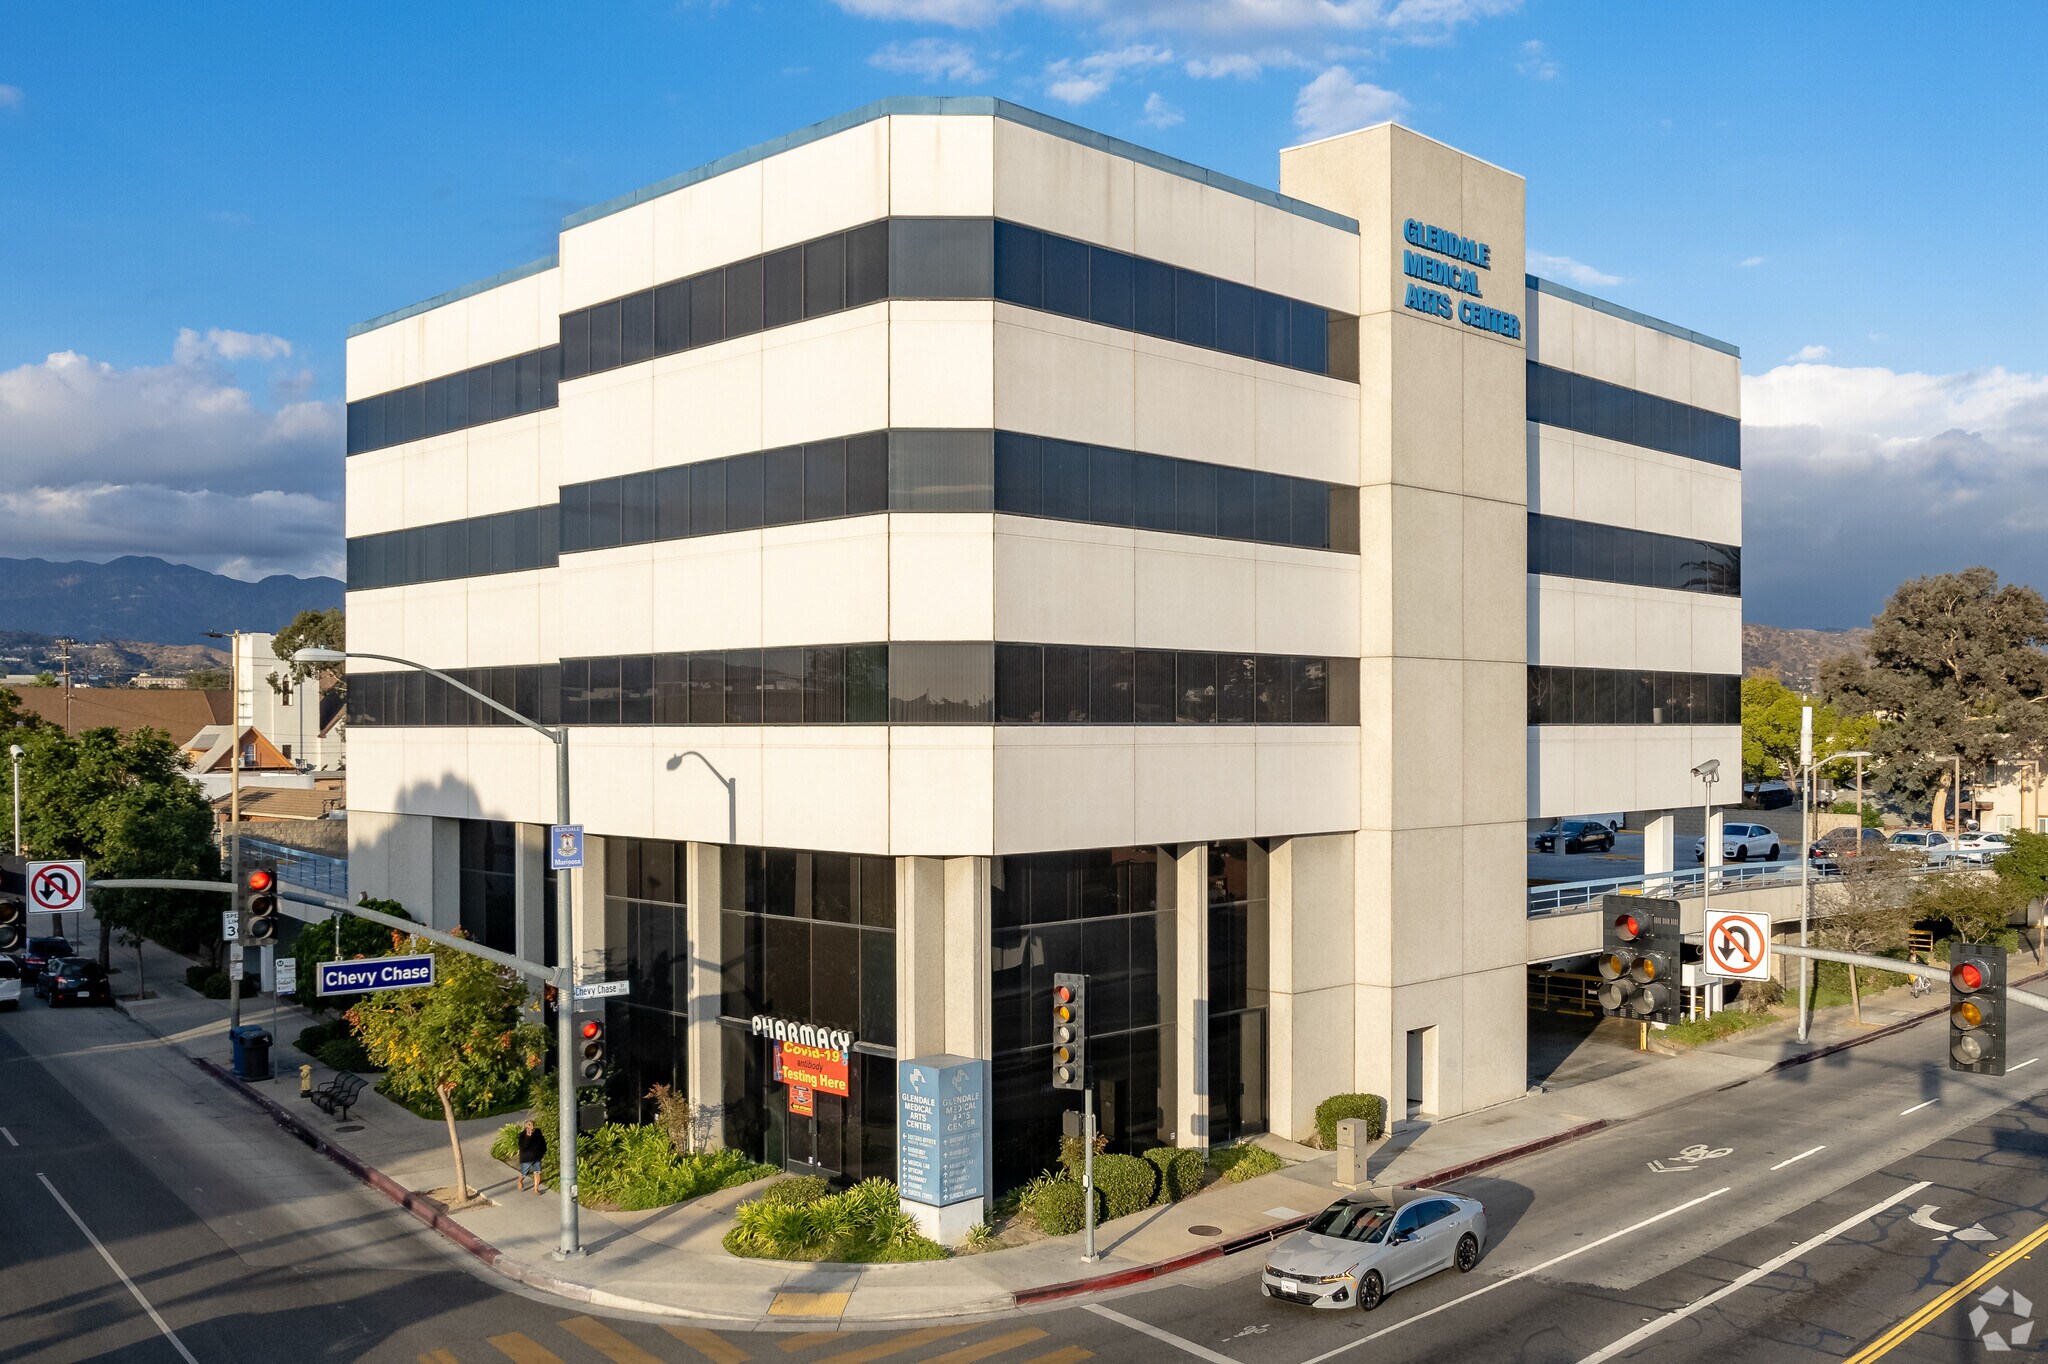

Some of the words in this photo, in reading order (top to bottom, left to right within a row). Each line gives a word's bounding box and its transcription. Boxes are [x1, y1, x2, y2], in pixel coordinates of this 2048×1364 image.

[1404, 218, 1490, 270] GLENDALE
[1404, 249, 1482, 298] MEDICAL
[1404, 283, 1453, 320] ARTS
[1458, 299, 1521, 340] CENTER
[326, 971, 377, 986] Chevy
[382, 966, 428, 981] Chase
[576, 987, 596, 996] Chevy
[598, 985, 616, 994] Chase
[752, 1015, 851, 1053] PHARMACY
[783, 1041, 840, 1062] Covid-19
[797, 1060, 824, 1072] antibody
[782, 1066, 818, 1087] Testing
[820, 1074, 846, 1090] Here
[902, 1093, 936, 1106] GLENDALE
[942, 1093, 980, 1106] GLENDALE
[904, 1102, 933, 1114] MEDICAL
[910, 1112, 926, 1122] ARTS
[906, 1120, 932, 1132] CENTER
